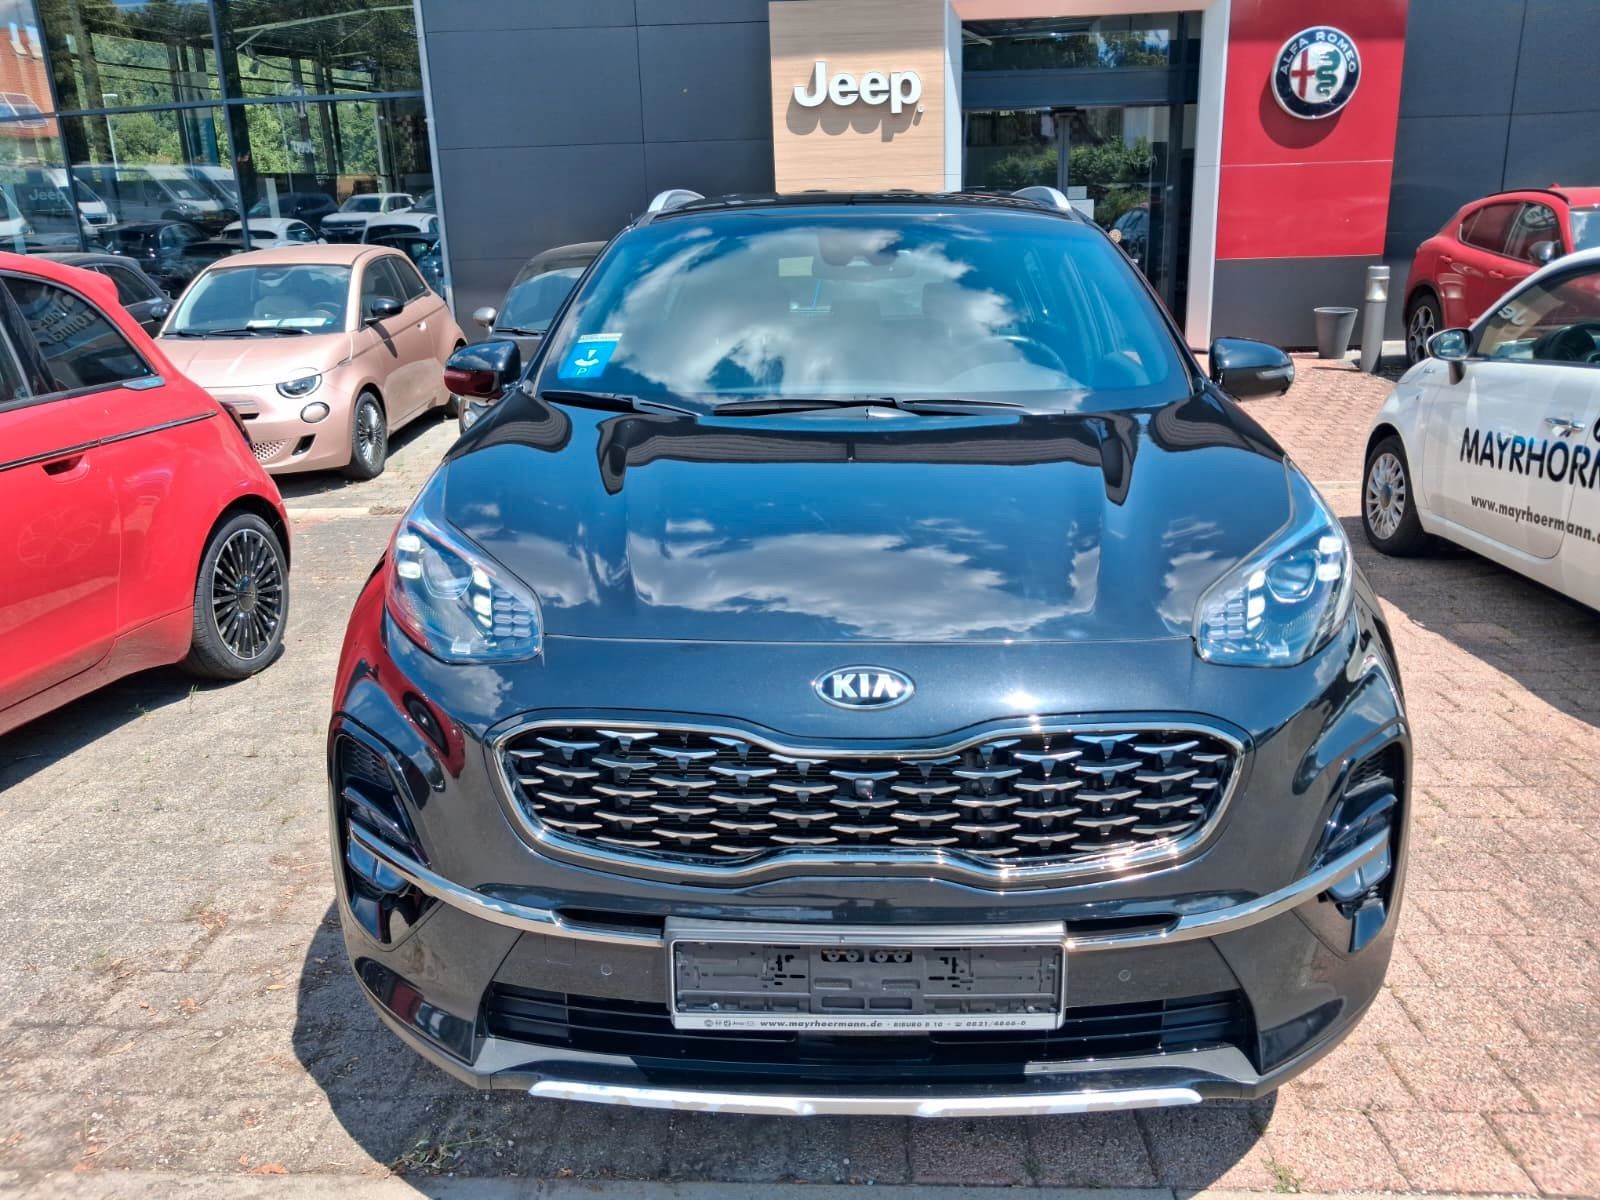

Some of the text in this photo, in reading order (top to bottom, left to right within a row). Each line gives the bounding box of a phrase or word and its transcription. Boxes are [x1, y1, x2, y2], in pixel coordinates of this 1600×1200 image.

[1280, 31, 1357, 75] ALFA ROMEO
[793, 60, 922, 114] Jeep
[832, 673, 899, 699] KIA
[760, 1019, 882, 1029] www.mayrhoermann.de
